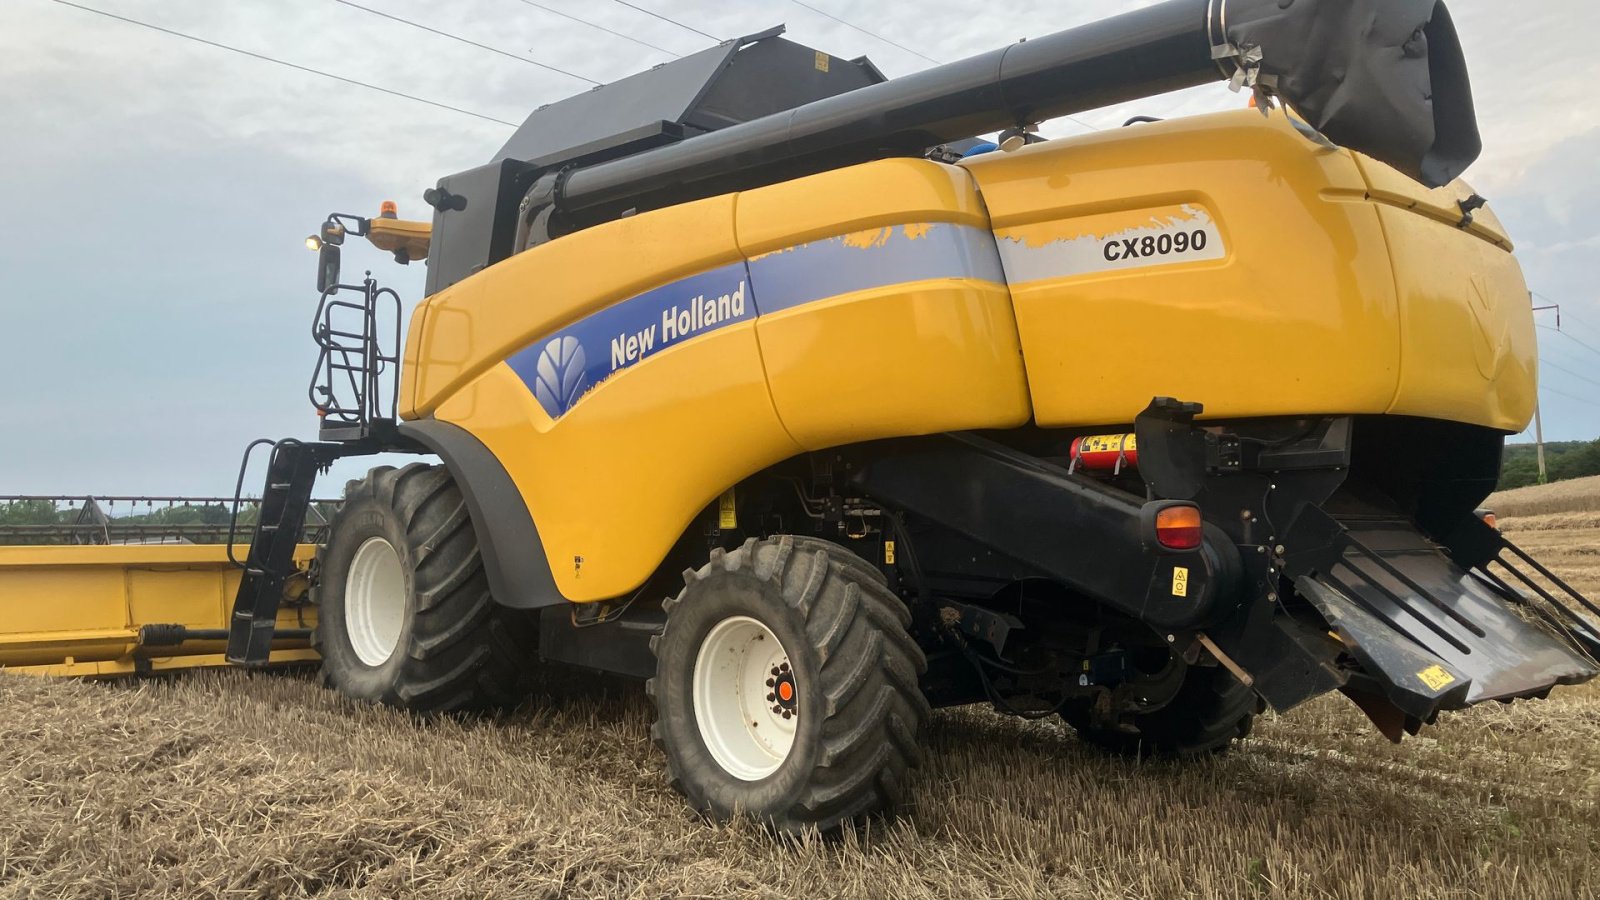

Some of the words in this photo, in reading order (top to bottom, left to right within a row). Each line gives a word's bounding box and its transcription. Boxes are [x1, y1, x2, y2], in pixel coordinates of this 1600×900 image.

[1103, 229, 1207, 261] CX8090
[611, 324, 656, 370] New
[662, 281, 745, 344] Holland
